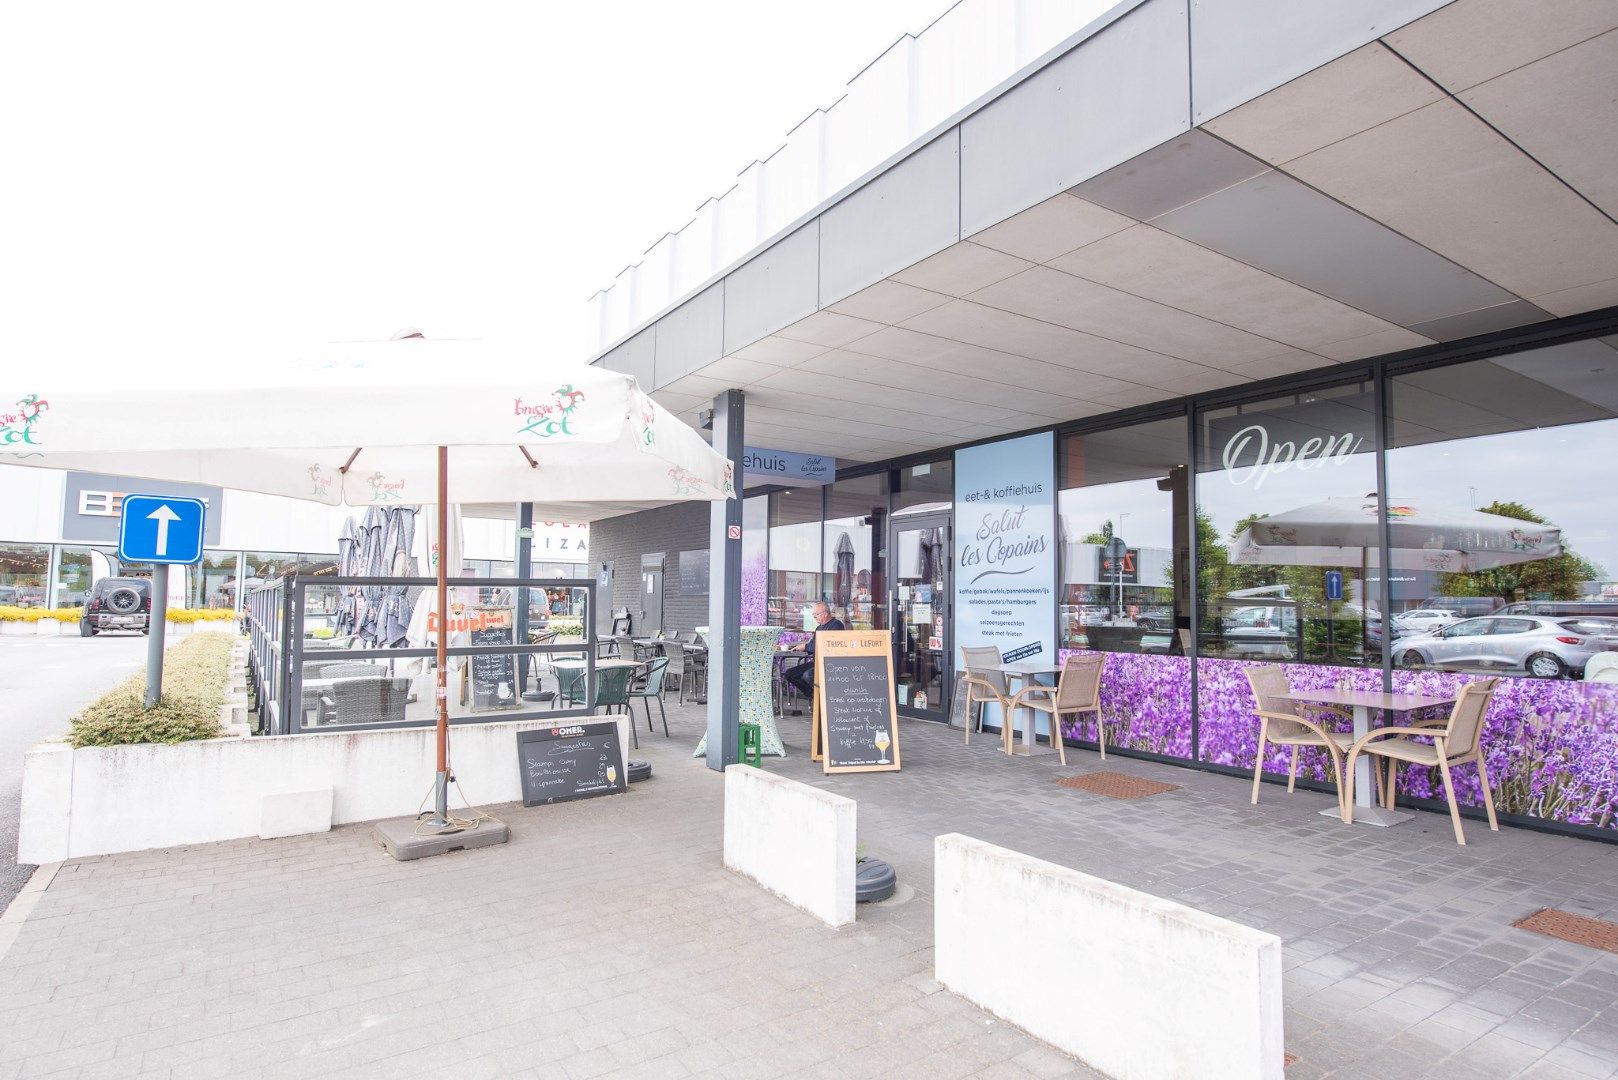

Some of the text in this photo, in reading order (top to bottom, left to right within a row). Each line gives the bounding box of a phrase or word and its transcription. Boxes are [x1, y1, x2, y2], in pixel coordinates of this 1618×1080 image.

[743, 452, 786, 472] ehuis
[1222, 425, 1363, 490] Open
[965, 482, 1043, 502] eet-& koffiehuis
[976, 505, 1030, 541] Salut
[961, 535, 1048, 567] les Copains
[486, 615, 504, 624] uvel
[826, 663, 849, 674] Open
